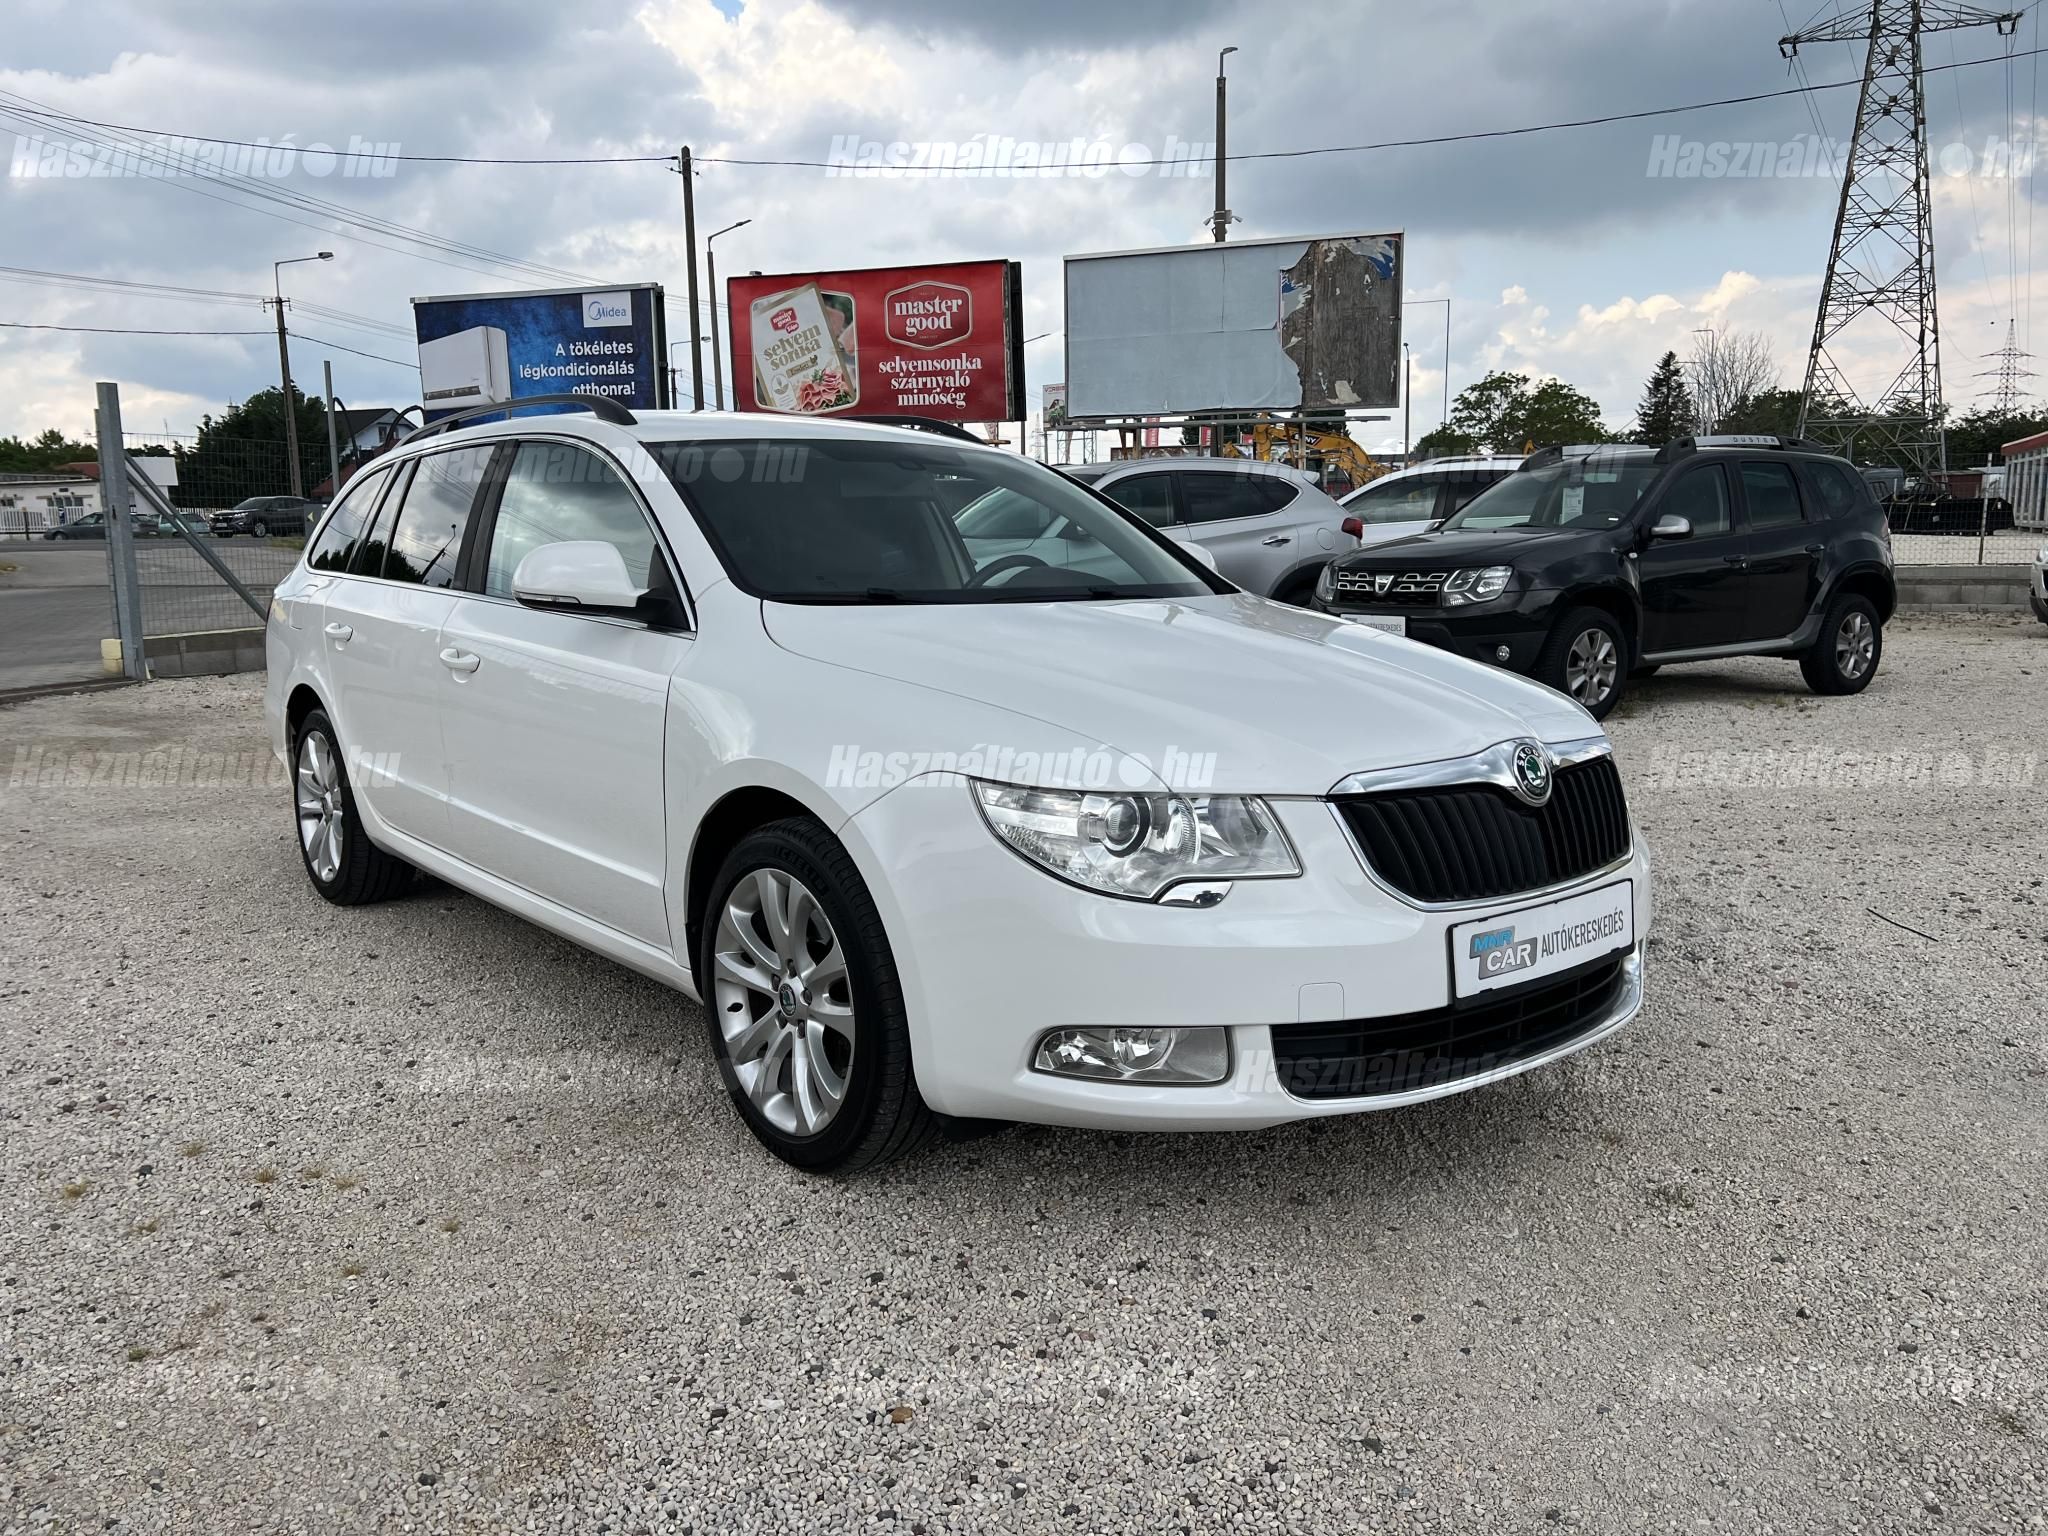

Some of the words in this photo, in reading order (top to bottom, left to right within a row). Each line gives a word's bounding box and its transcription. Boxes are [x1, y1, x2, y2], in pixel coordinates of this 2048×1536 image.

[589, 301, 627, 320] Midea
[895, 296, 962, 316] master
[906, 310, 952, 337] good
[555, 343, 566, 357] A
[569, 340, 634, 356] tökéletes
[519, 361, 635, 380] légkondicionálás
[879, 352, 982, 377] selyemsonka
[572, 381, 635, 396] otthonra!
[891, 370, 971, 391] szárnyaló
[898, 388, 966, 409] minőség
[1486, 943, 1532, 971] CAR
[1541, 906, 1624, 958] AUTÓKERESKEDÉS
